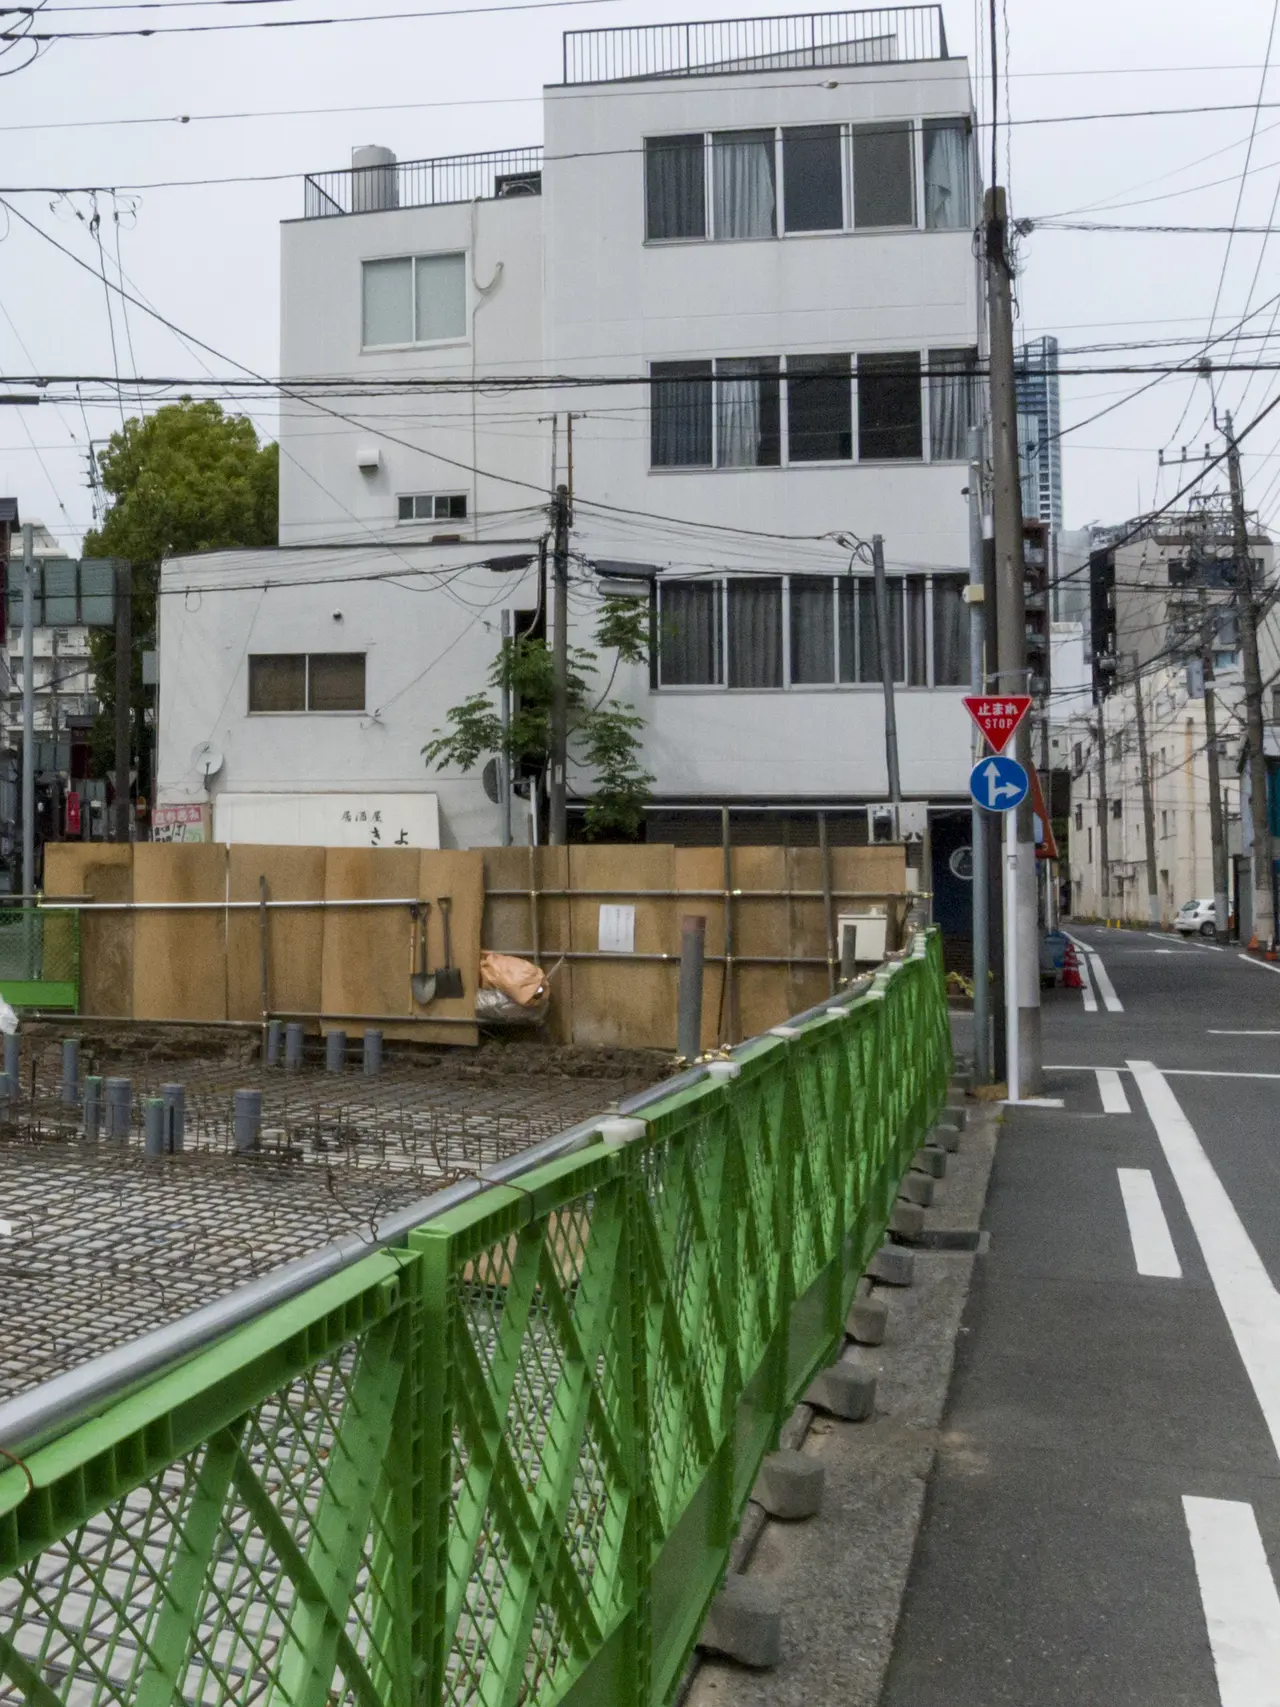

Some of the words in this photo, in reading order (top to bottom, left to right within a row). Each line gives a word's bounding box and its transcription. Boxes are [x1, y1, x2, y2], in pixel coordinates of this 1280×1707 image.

[977, 702, 1019, 716] 止まれ
[984, 718, 1013, 729] STOP
[341, 810, 383, 823] 居酒屋
